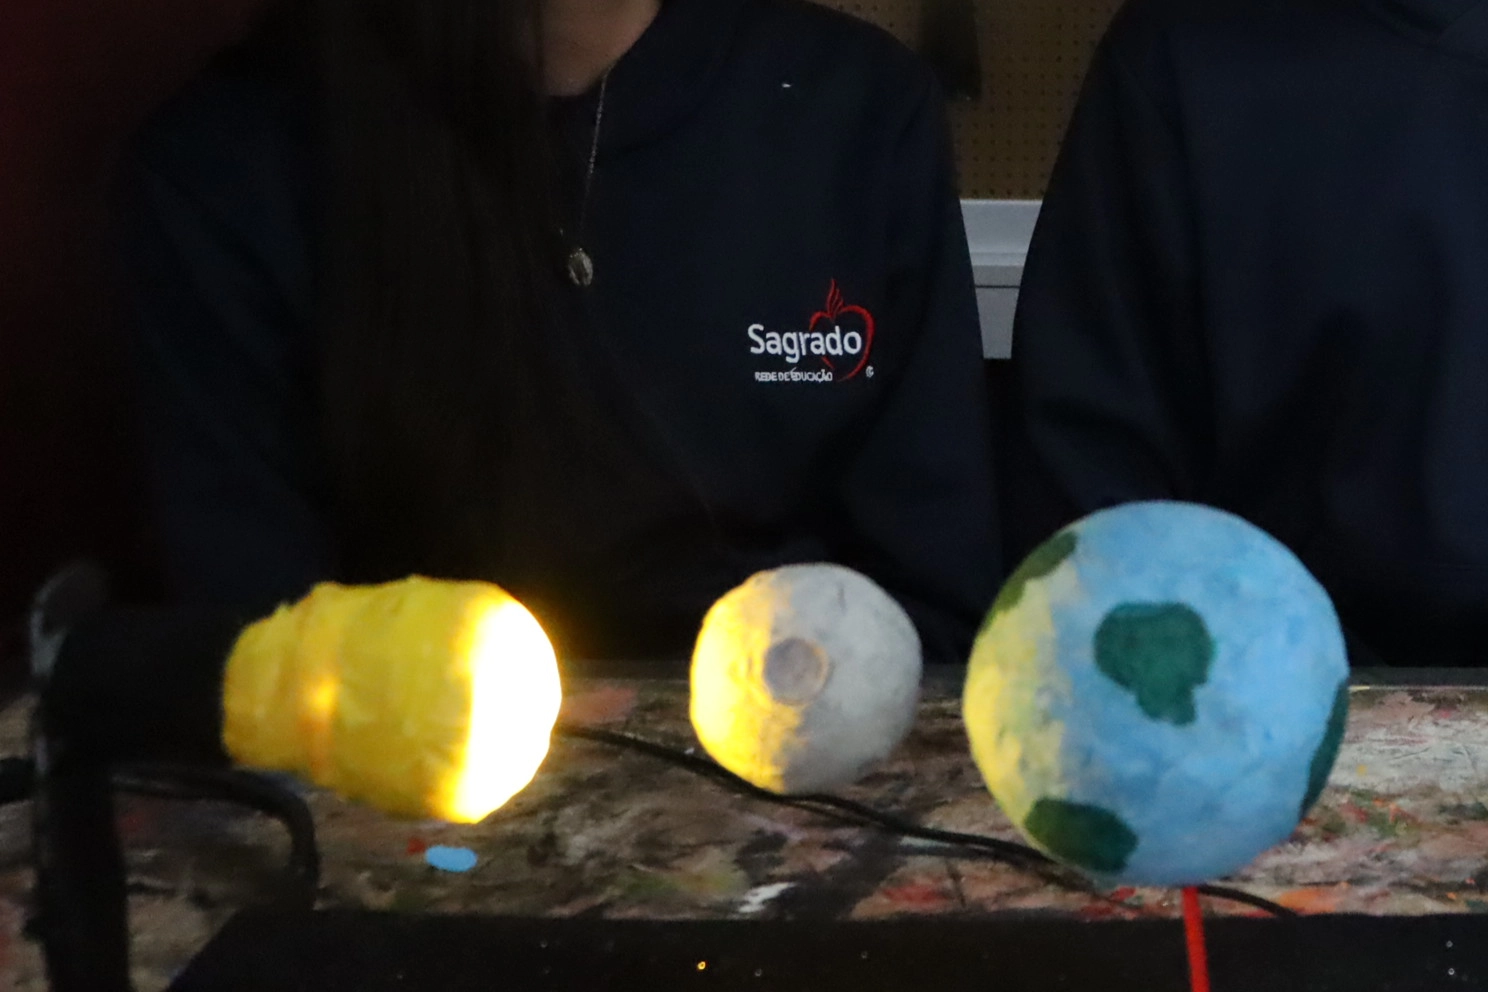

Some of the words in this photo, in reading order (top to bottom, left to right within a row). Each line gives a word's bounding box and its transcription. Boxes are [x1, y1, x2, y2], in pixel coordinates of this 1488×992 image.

[747, 323, 863, 364] Sagrado
[754, 371, 778, 382] REDE
[778, 371, 790, 382] DE
